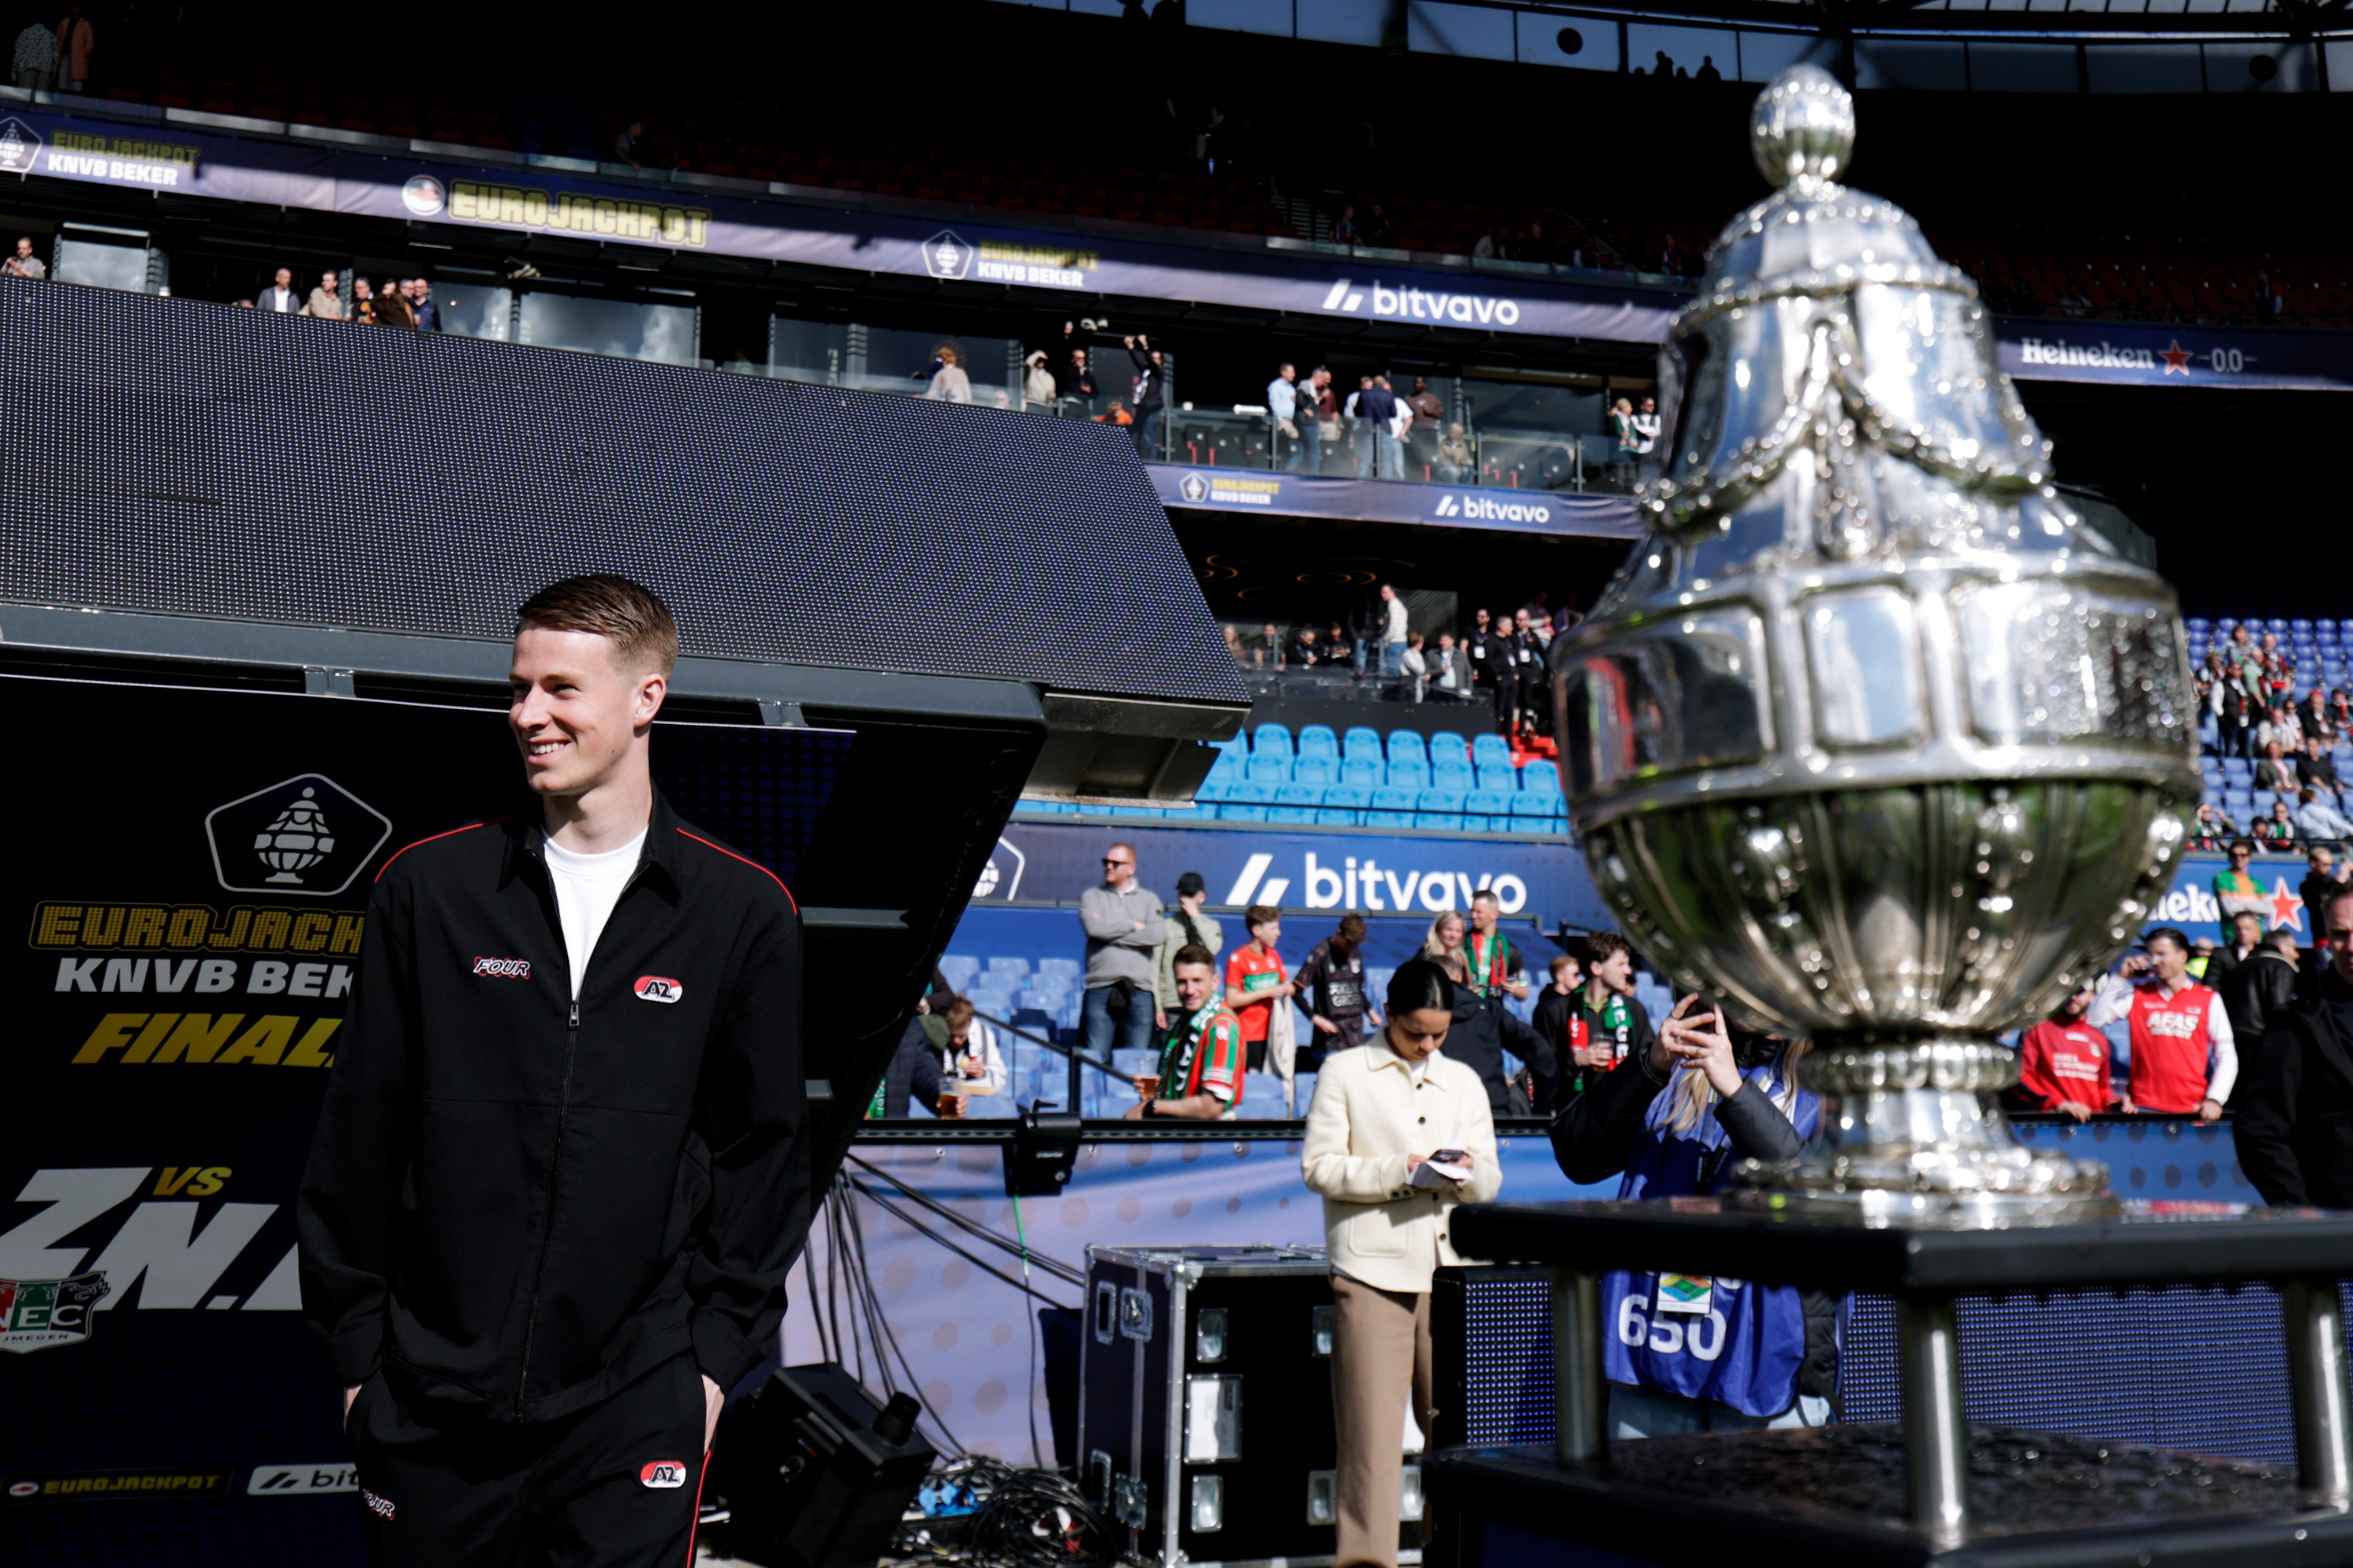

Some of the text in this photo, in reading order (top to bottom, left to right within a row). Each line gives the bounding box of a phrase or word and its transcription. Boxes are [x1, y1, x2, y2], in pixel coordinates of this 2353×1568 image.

[52, 130, 198, 167] EUROJACKPOT
[48, 154, 179, 186] KNVB BEKER
[451, 181, 708, 245] EUROJACKPOT
[978, 262, 1084, 287] KNVB BEKER
[1373, 279, 1519, 325] bitvavo
[2021, 337, 2155, 369] Heineken
[1464, 496, 1550, 523] bitvavo
[1306, 852, 1528, 914] bitvavo
[55, 958, 237, 993] KNVB
[473, 958, 531, 978] FOUR
[642, 980, 674, 1000] AZ
[71, 1013, 342, 1067] FINAL
[152, 1167, 232, 1196] VS
[1618, 1293, 1727, 1361] 650
[44, 1475, 220, 1495] EUROJACKPOT
[649, 1464, 681, 1484] AZ
